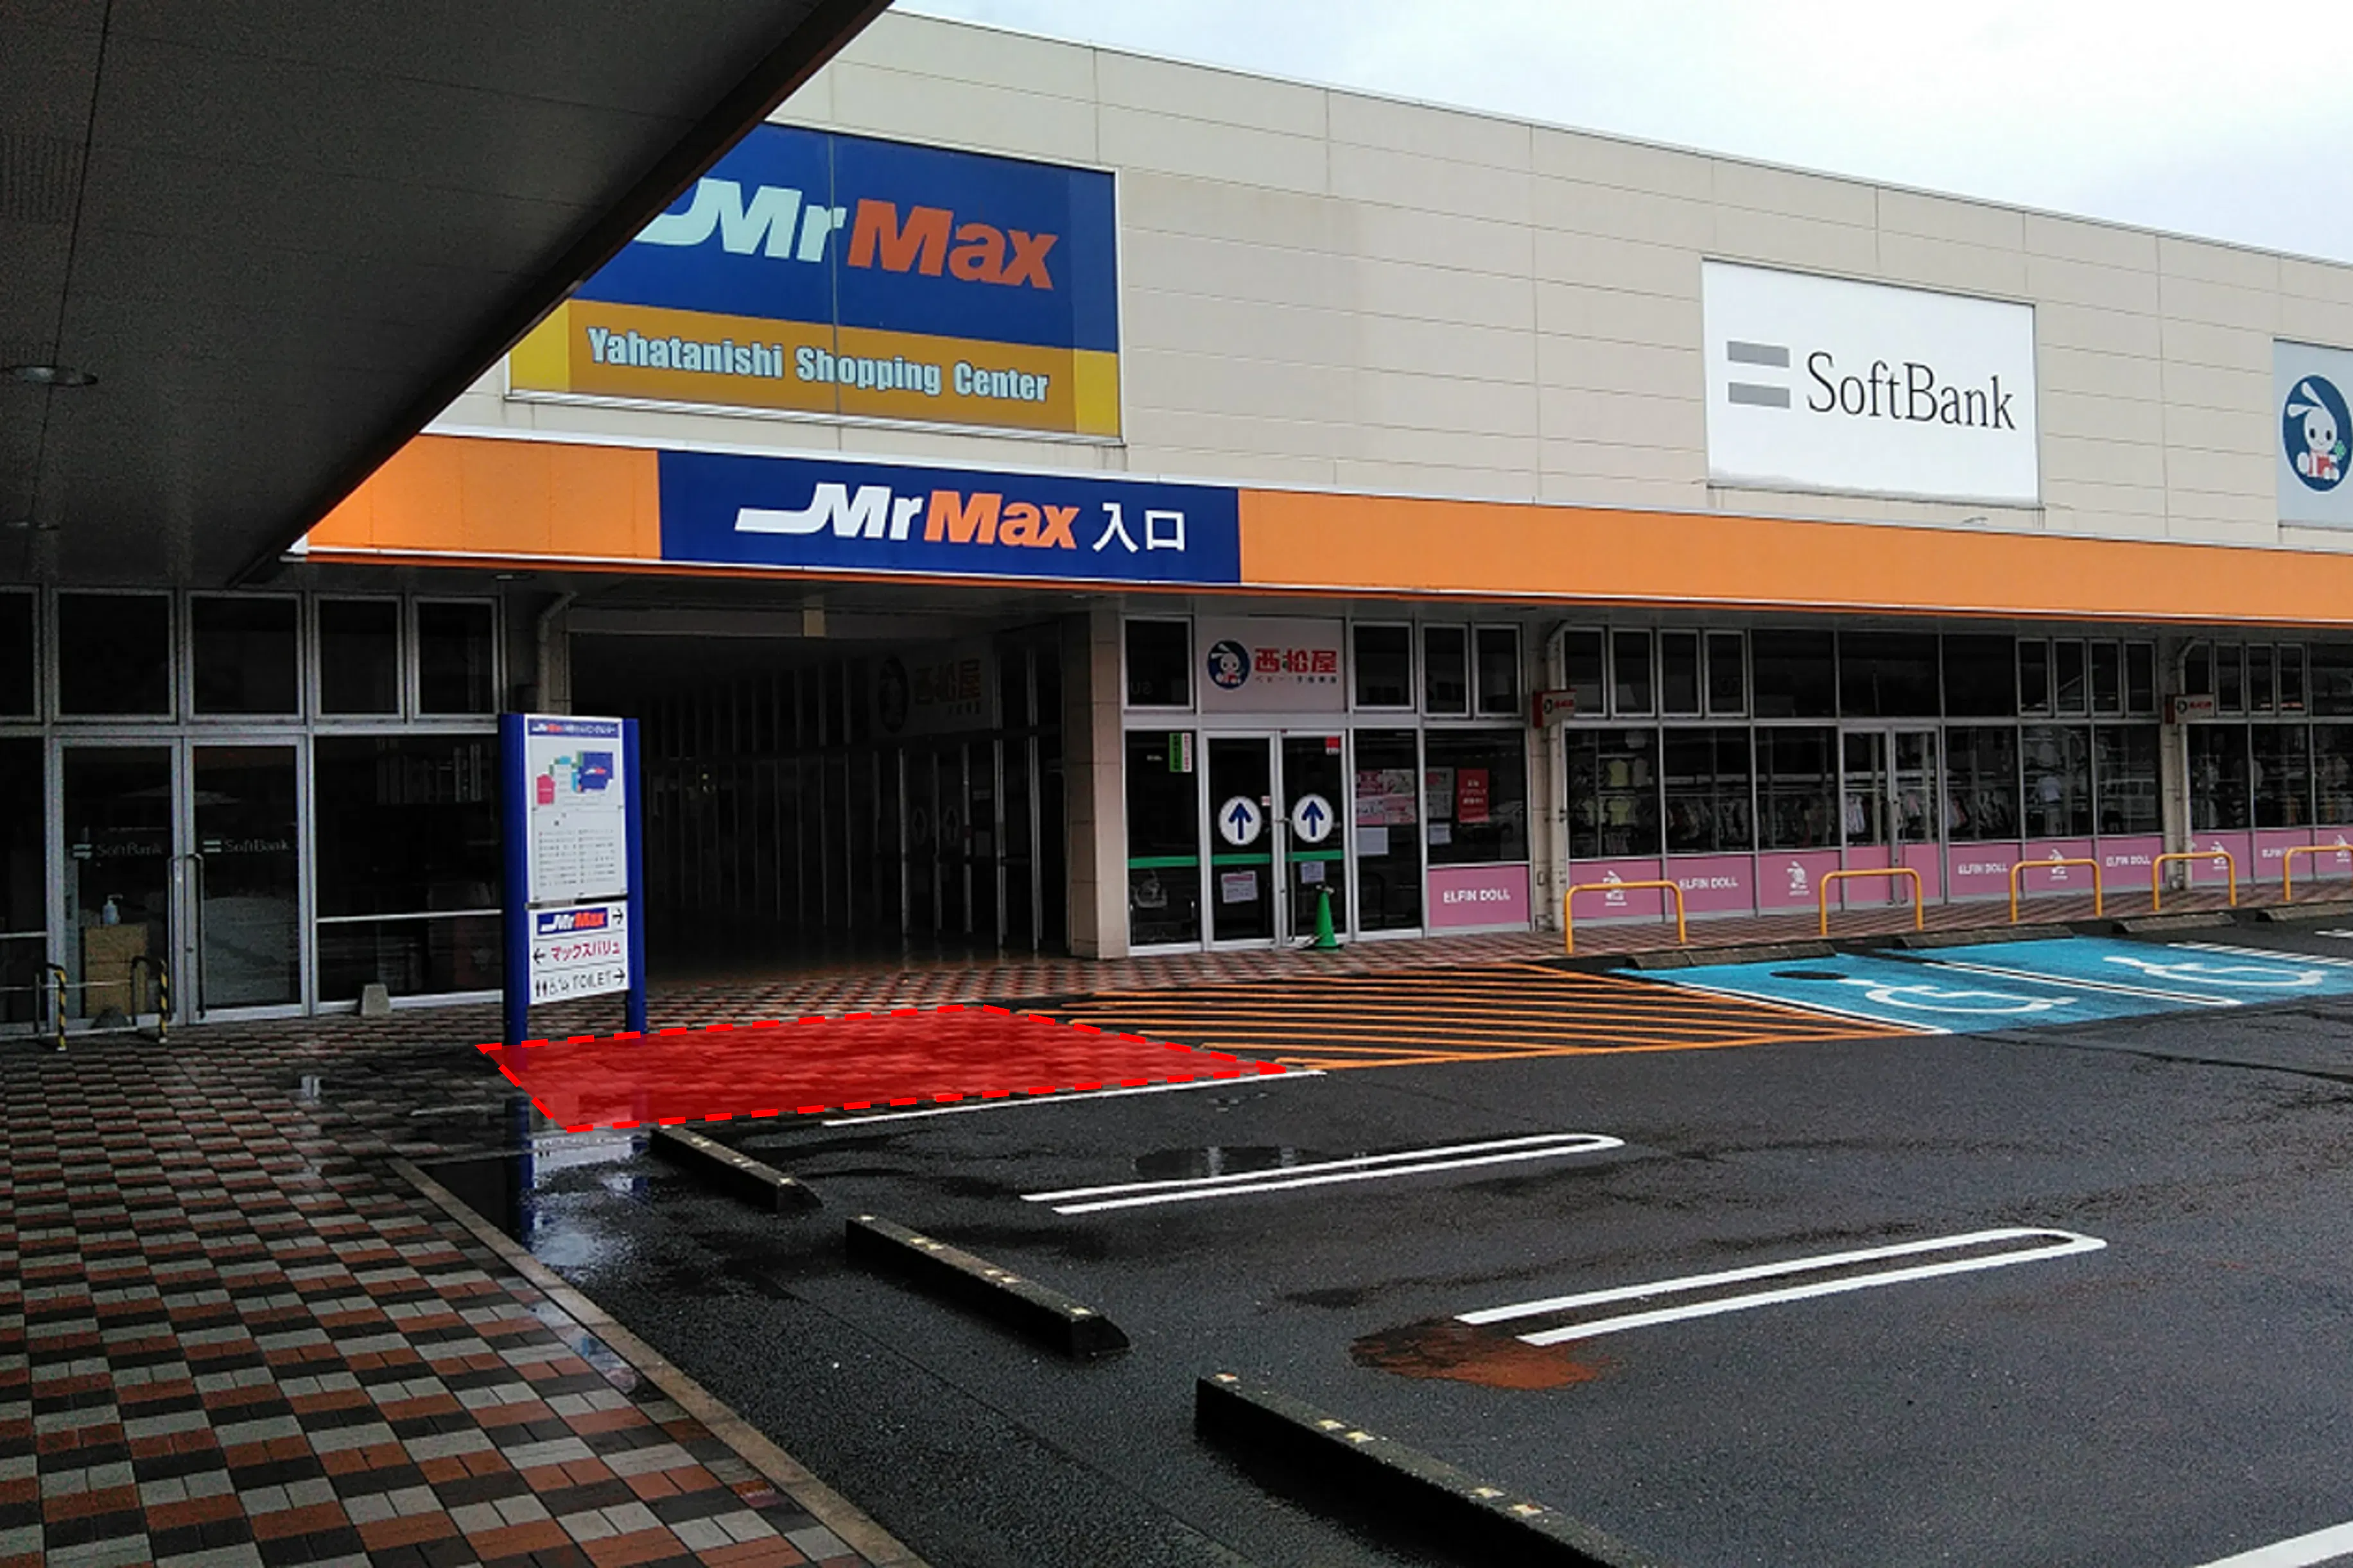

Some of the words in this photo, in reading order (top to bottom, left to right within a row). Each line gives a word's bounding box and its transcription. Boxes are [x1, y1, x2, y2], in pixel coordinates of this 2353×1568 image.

[587, 326, 785, 379] Yahatanishi
[795, 347, 942, 397] Shopping
[953, 361, 1049, 402] Center
[1807, 351, 2017, 431] SoftBank
[734, 482, 1081, 550] MrMax
[1091, 502, 1185, 553] 入口
[1255, 649, 1337, 674] 西松屋
[1443, 890, 1477, 904] ELFIN
[1479, 888, 1511, 901] DOLL
[573, 970, 612, 990] TOILET
